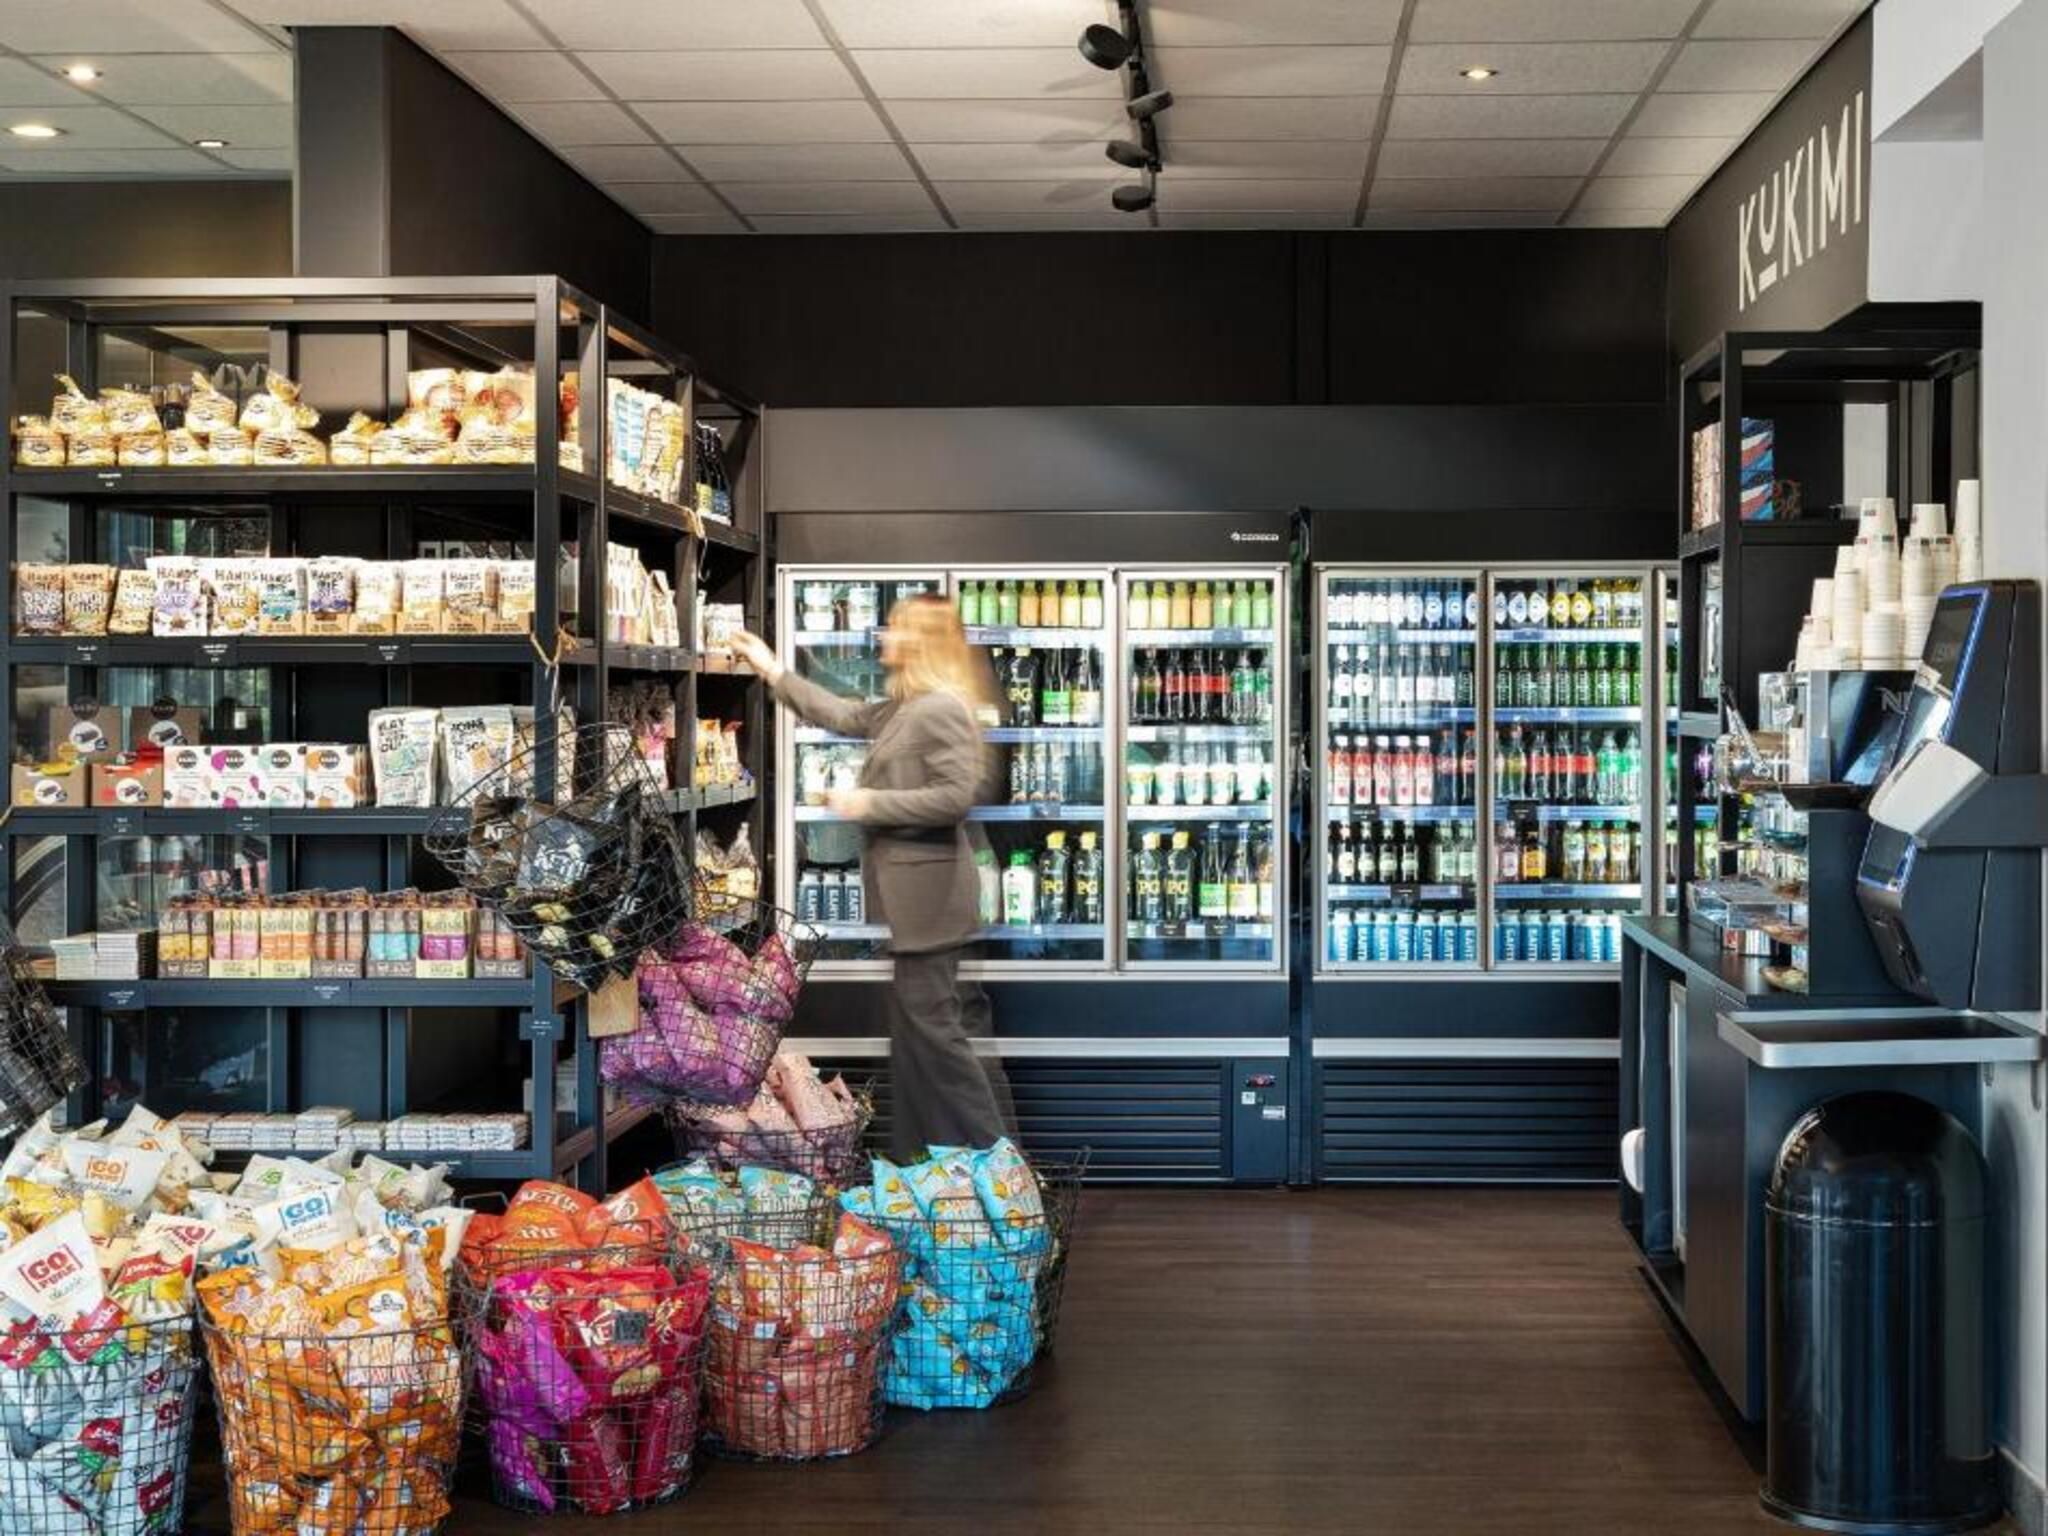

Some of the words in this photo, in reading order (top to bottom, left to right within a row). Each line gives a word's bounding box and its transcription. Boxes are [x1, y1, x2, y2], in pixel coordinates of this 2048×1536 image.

[1738, 91, 1863, 313] KUKIMI
[285, 1197, 323, 1219] GO
[28, 1252, 67, 1280] GO
